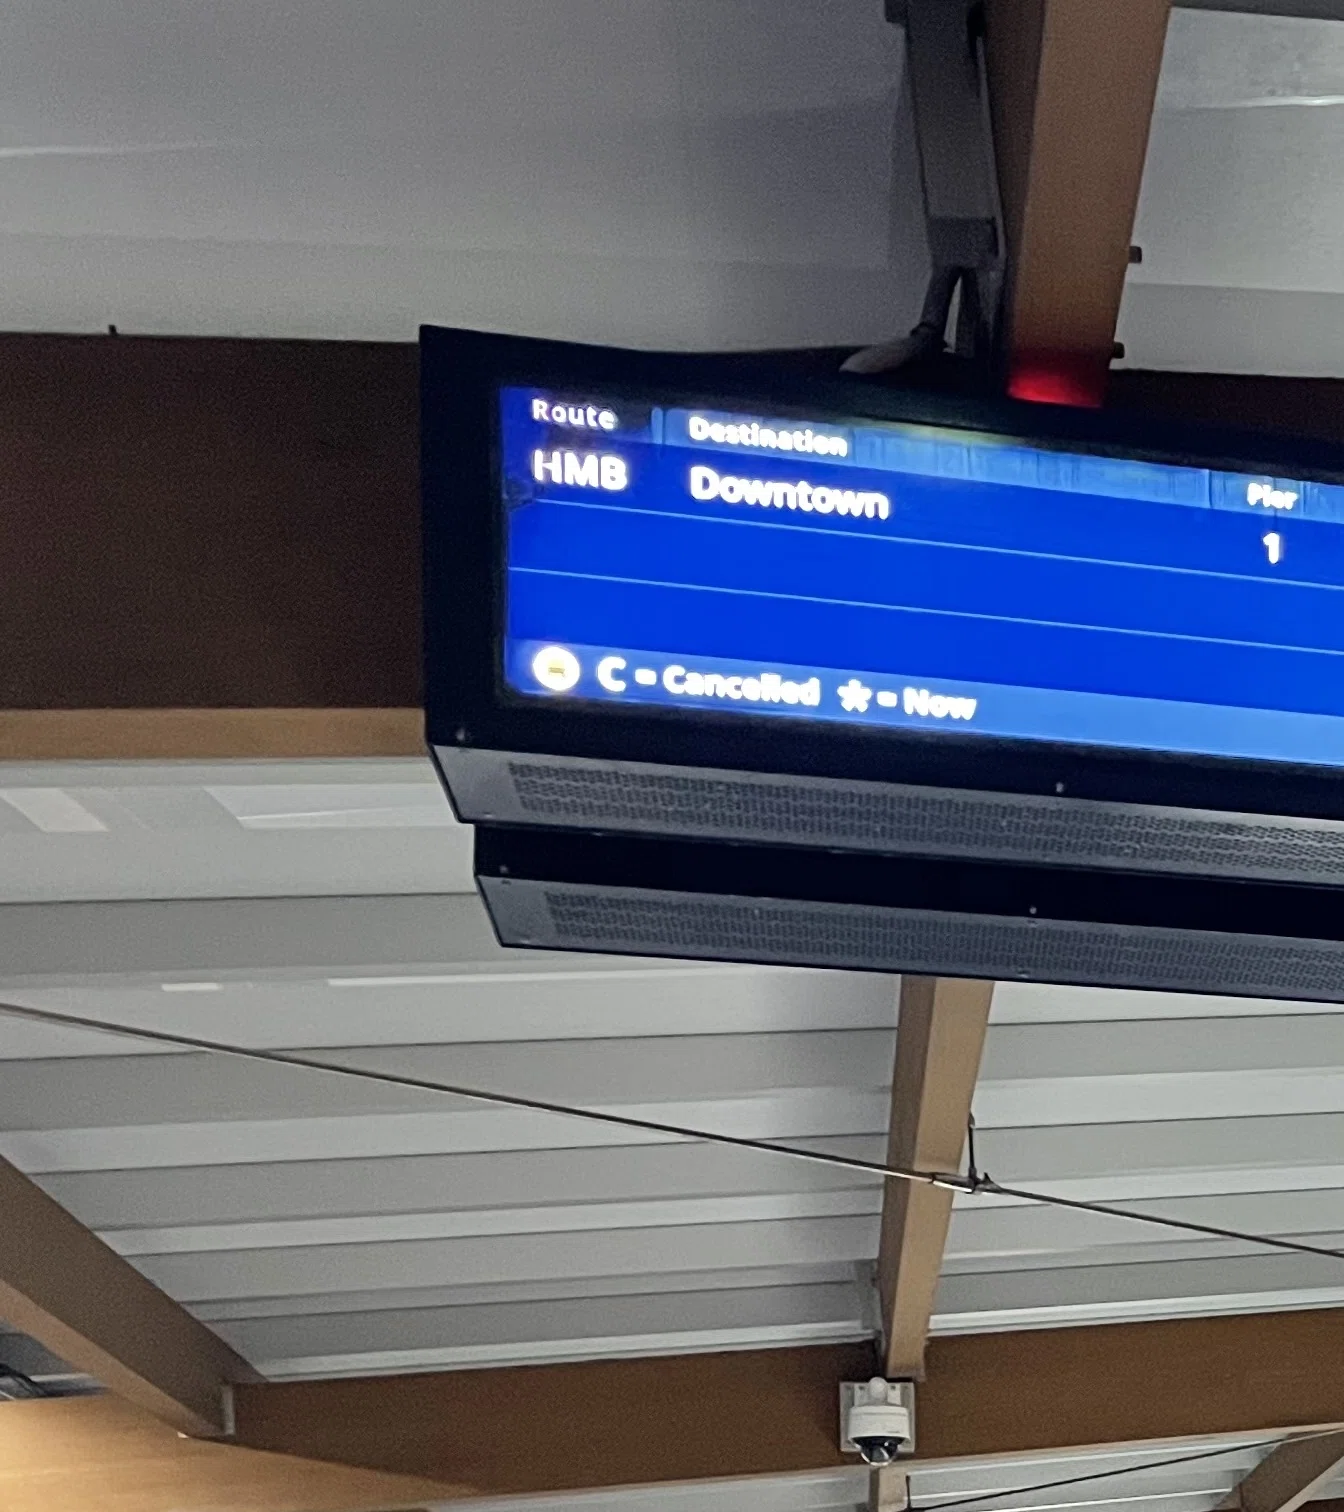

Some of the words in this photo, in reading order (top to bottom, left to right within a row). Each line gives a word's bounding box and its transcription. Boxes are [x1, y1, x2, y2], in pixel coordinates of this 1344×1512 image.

[532, 399, 618, 429] Route
[688, 415, 848, 457] Destination
[1247, 483, 1298, 510] Pier
[533, 449, 628, 491] HMB
[689, 466, 889, 520] Downtown
[1263, 532, 1280, 564] 1
[598, 656, 627, 692] C
[663, 664, 821, 706] Cancelled
[904, 687, 977, 720] Now
